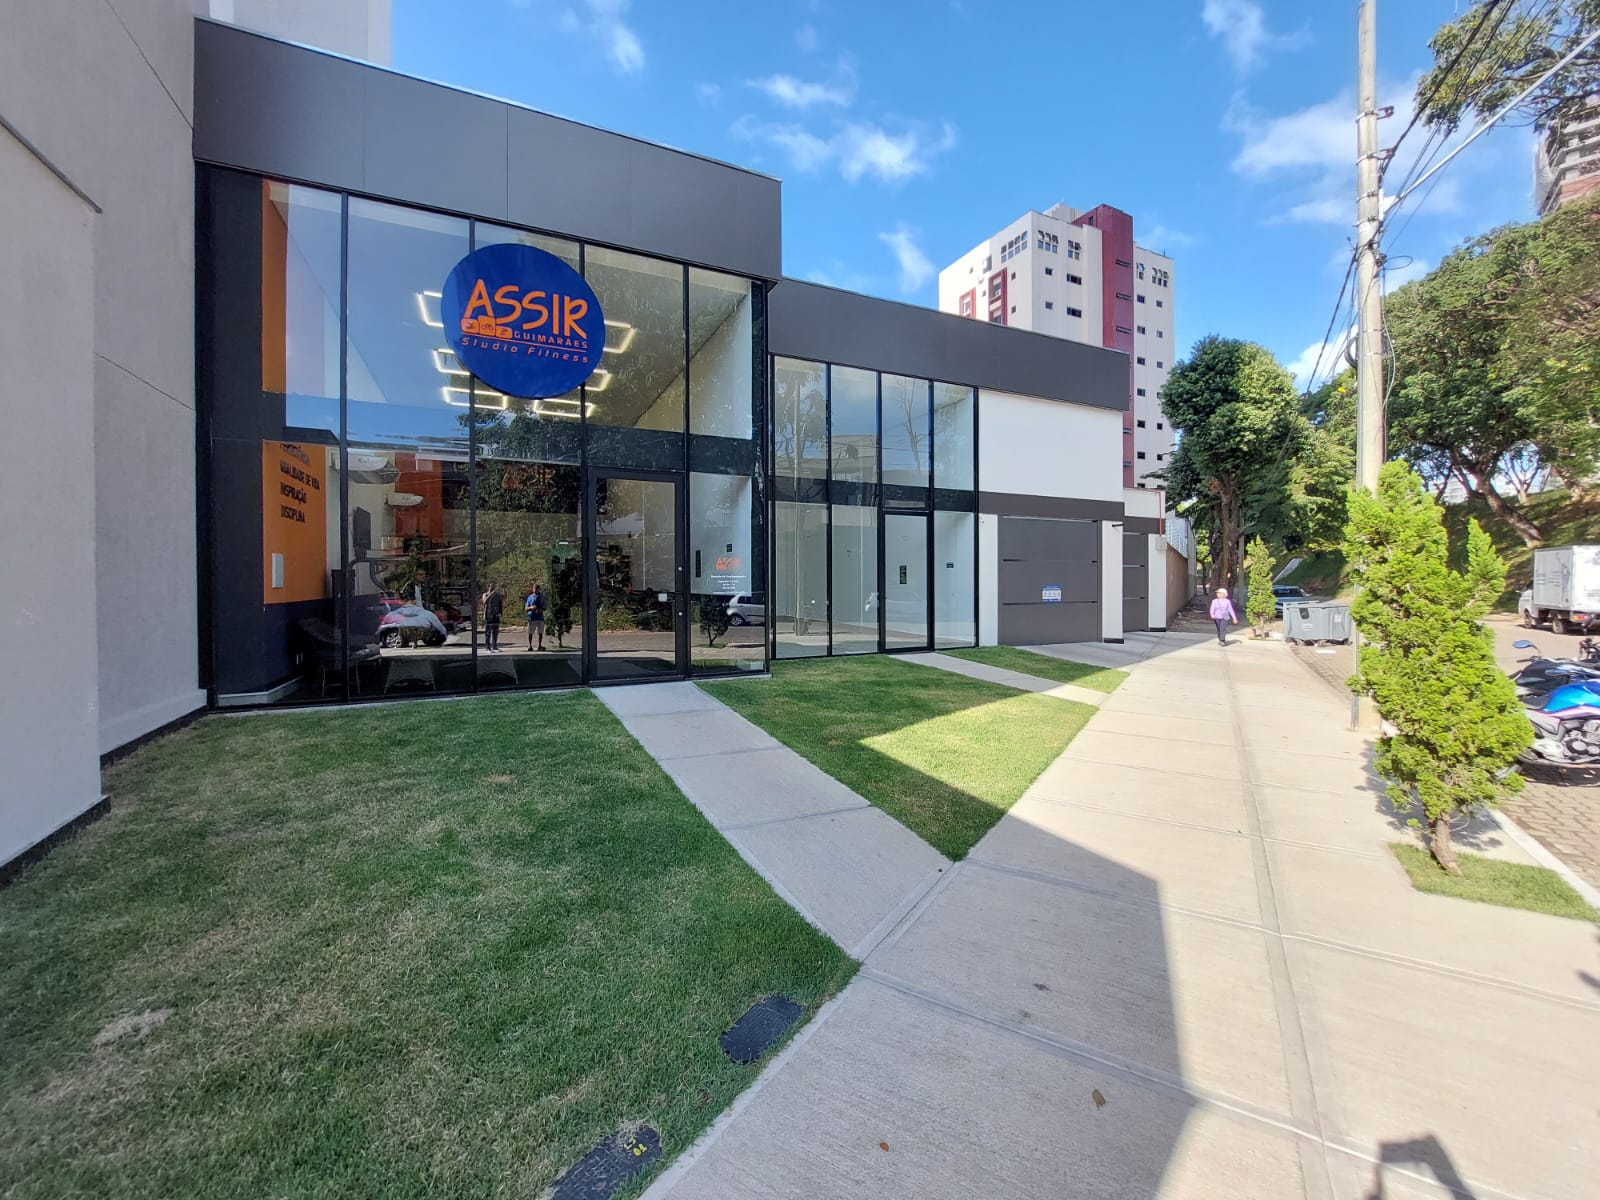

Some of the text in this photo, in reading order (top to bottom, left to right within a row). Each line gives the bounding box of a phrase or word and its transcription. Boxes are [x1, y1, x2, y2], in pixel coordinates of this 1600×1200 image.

[463, 278, 588, 339] ASSIR
[462, 338, 589, 363] Studio Fitness
